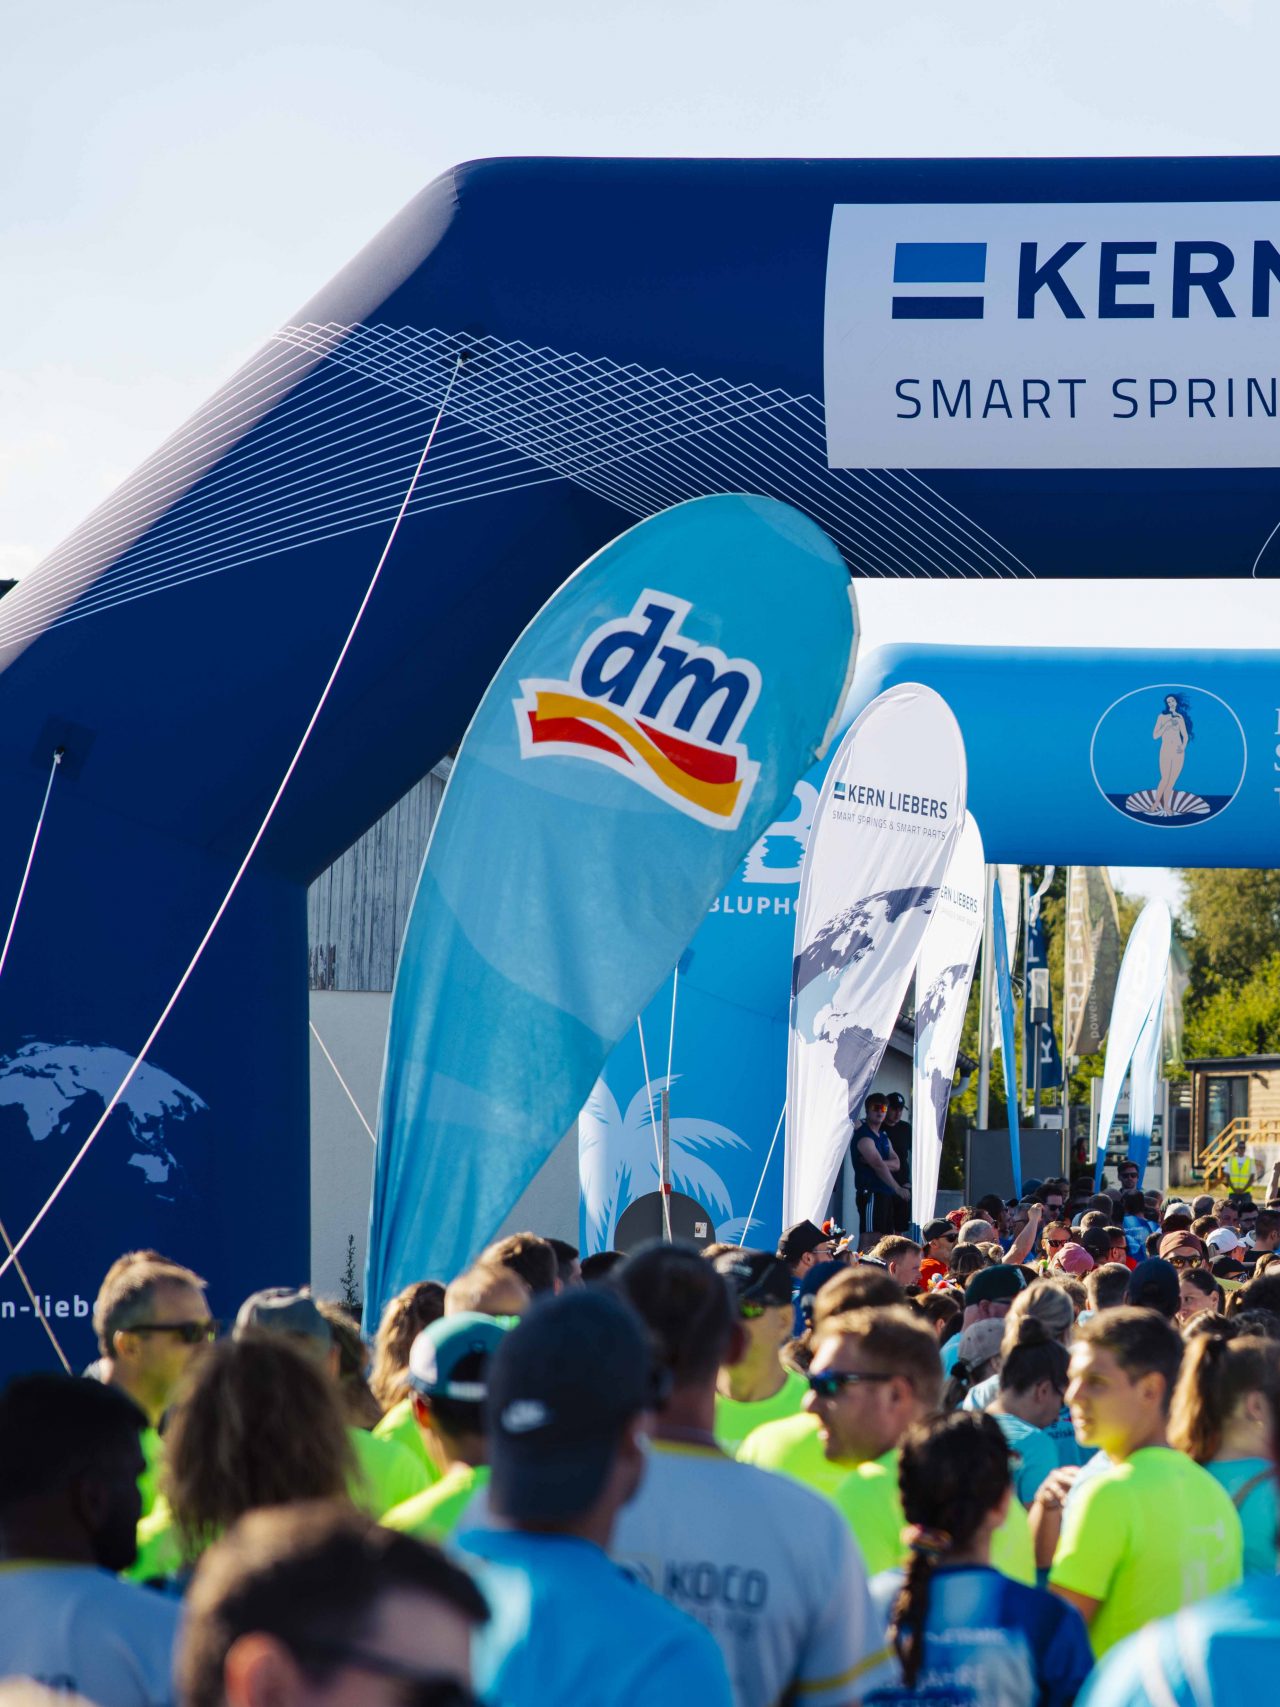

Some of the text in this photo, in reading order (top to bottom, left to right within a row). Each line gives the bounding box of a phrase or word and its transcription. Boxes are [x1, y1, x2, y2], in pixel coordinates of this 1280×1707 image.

[895, 377, 1087, 420] SMART
[580, 603, 751, 745] dm
[848, 783, 948, 820] KERN LIEBERS
[832, 810, 856, 822] SMART
[889, 821, 894, 830] &
[896, 823, 921, 835] SMART
[923, 828, 946, 840] PARTS
[953, 890, 978, 913] LIEBERS
